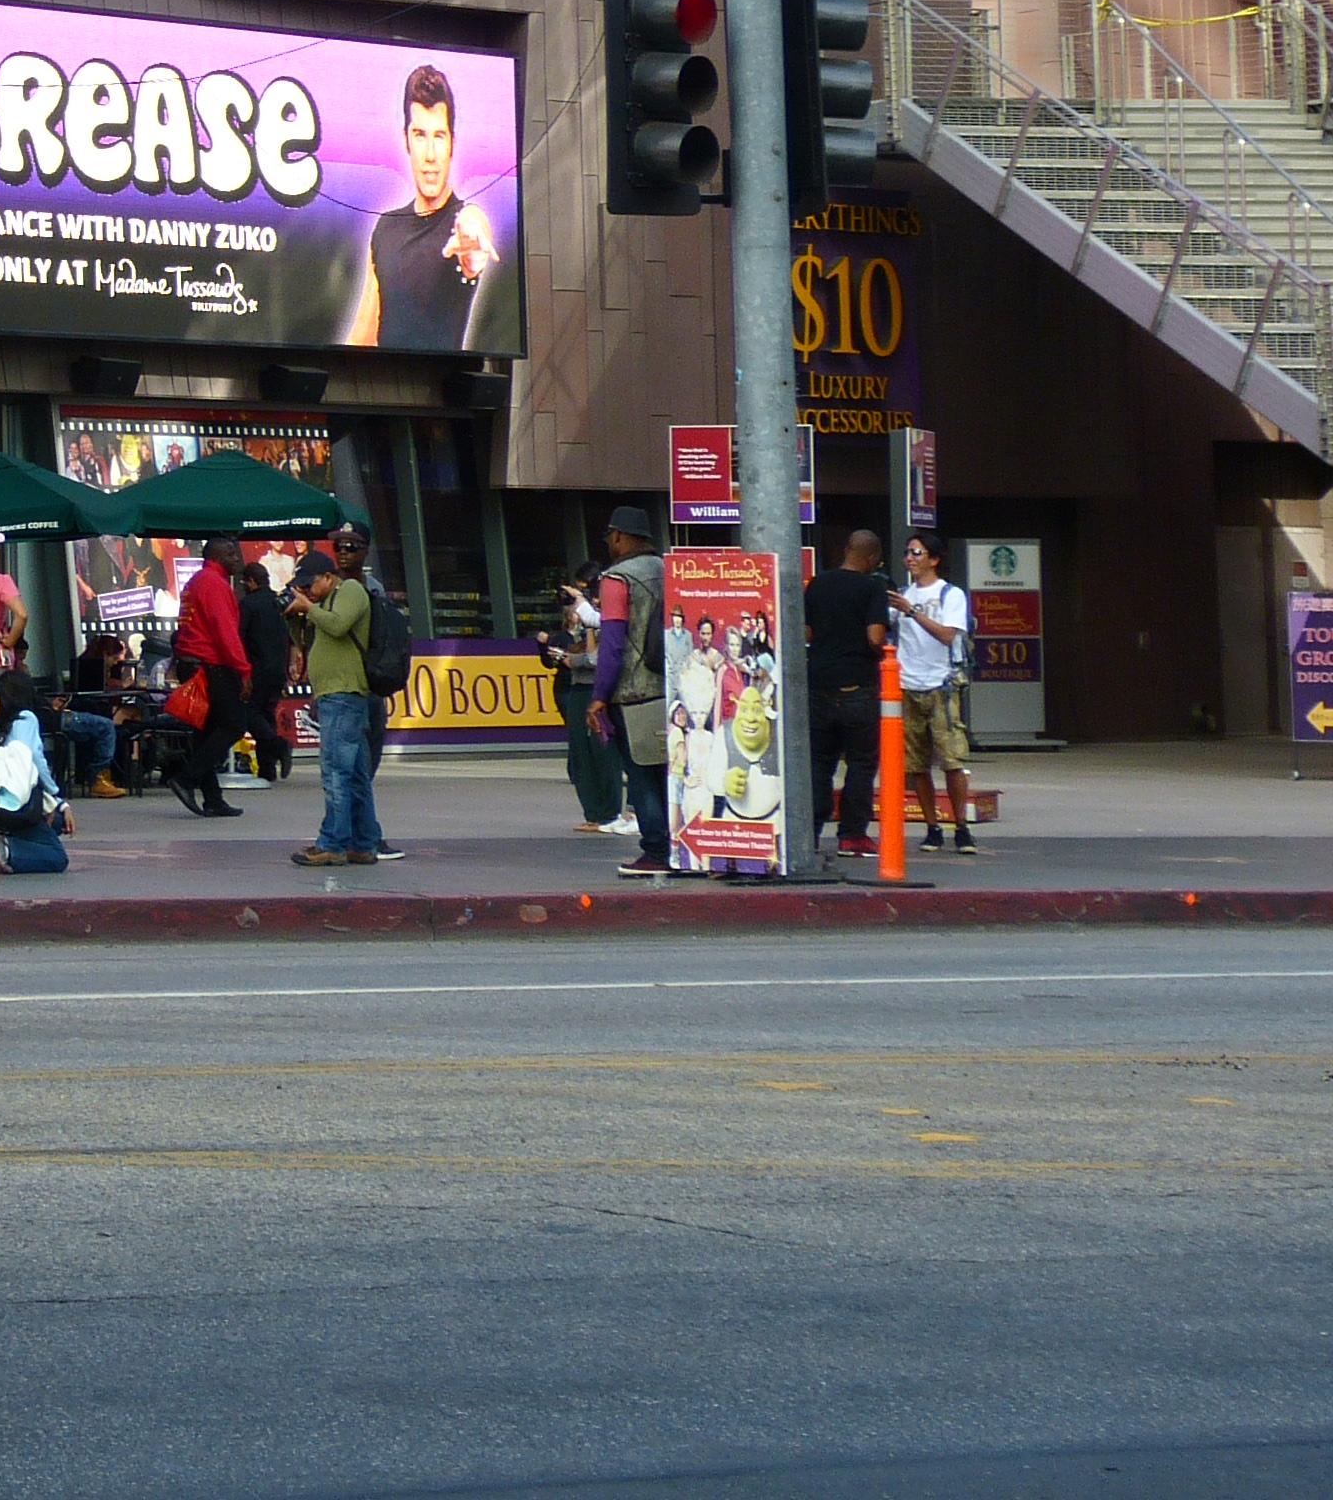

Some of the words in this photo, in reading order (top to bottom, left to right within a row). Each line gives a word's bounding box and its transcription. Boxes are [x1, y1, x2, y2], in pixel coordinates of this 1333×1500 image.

[56, 212, 125, 243] WITH
[128, 218, 212, 249] DANNY
[214, 223, 278, 253] ZUKO
[55, 258, 89, 287] AT
[94, 257, 173, 298] Madame
[164, 262, 248, 316] Tussauds
[792, 243, 904, 363] $10
[809, 370, 890, 400] LUXURY
[27, 520, 59, 529] COFFEE
[242, 519, 291, 528] STARBUCKS
[291, 517, 322, 525] COFFEE
[690, 506, 740, 517] William
[672, 559, 718, 581] Madame
[712, 558, 763, 587] Tussauds
[1302, 627, 1333, 643] TO
[987, 641, 1027, 665] $10
[445, 668, 559, 716] BOUT
